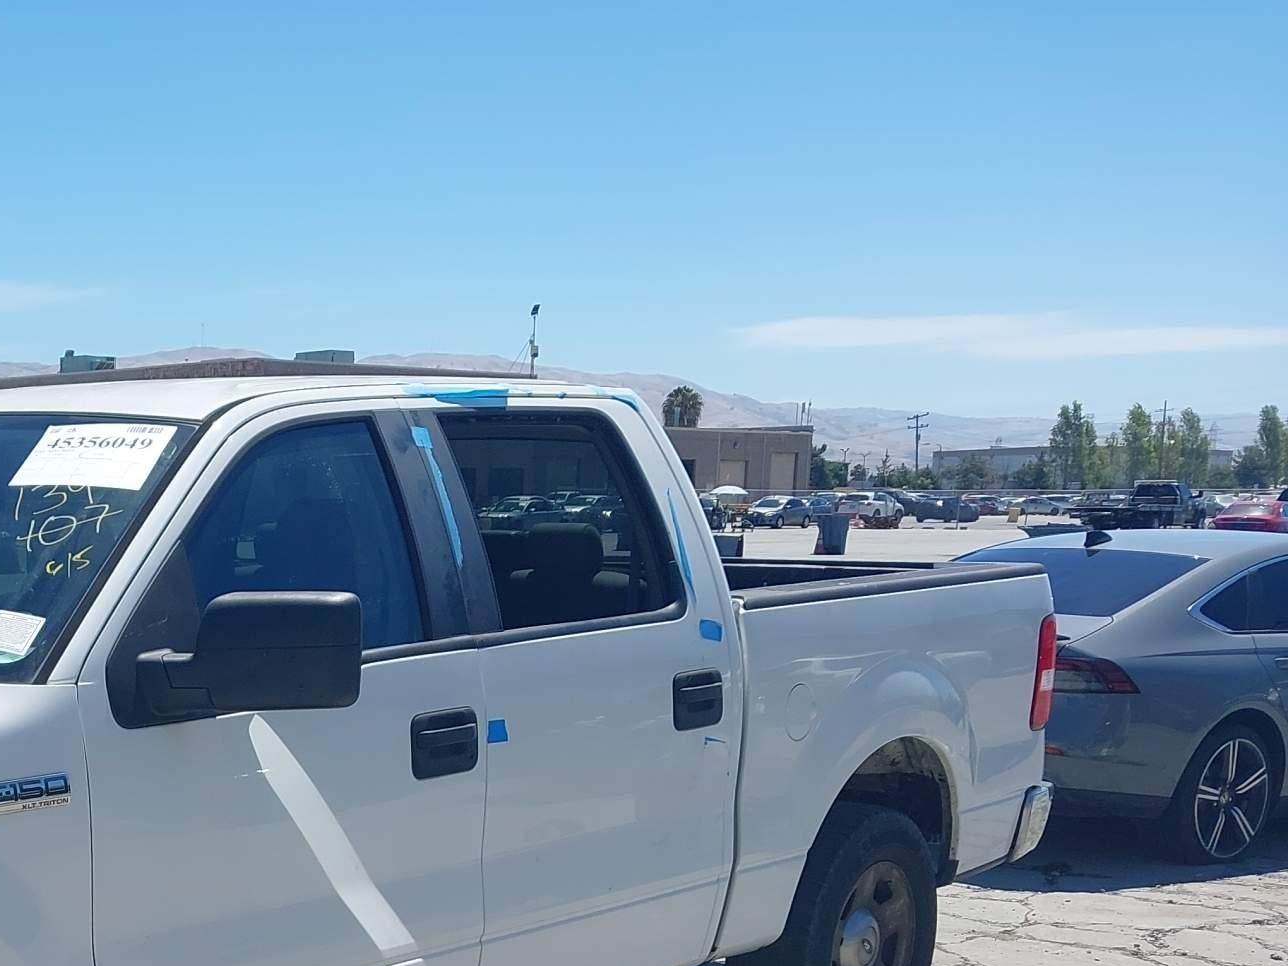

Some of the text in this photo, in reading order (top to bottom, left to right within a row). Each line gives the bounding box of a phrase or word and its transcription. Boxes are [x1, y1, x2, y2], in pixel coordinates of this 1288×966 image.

[48, 436, 153, 450] 45356049
[21, 797, 69, 810] XLT TRITON
